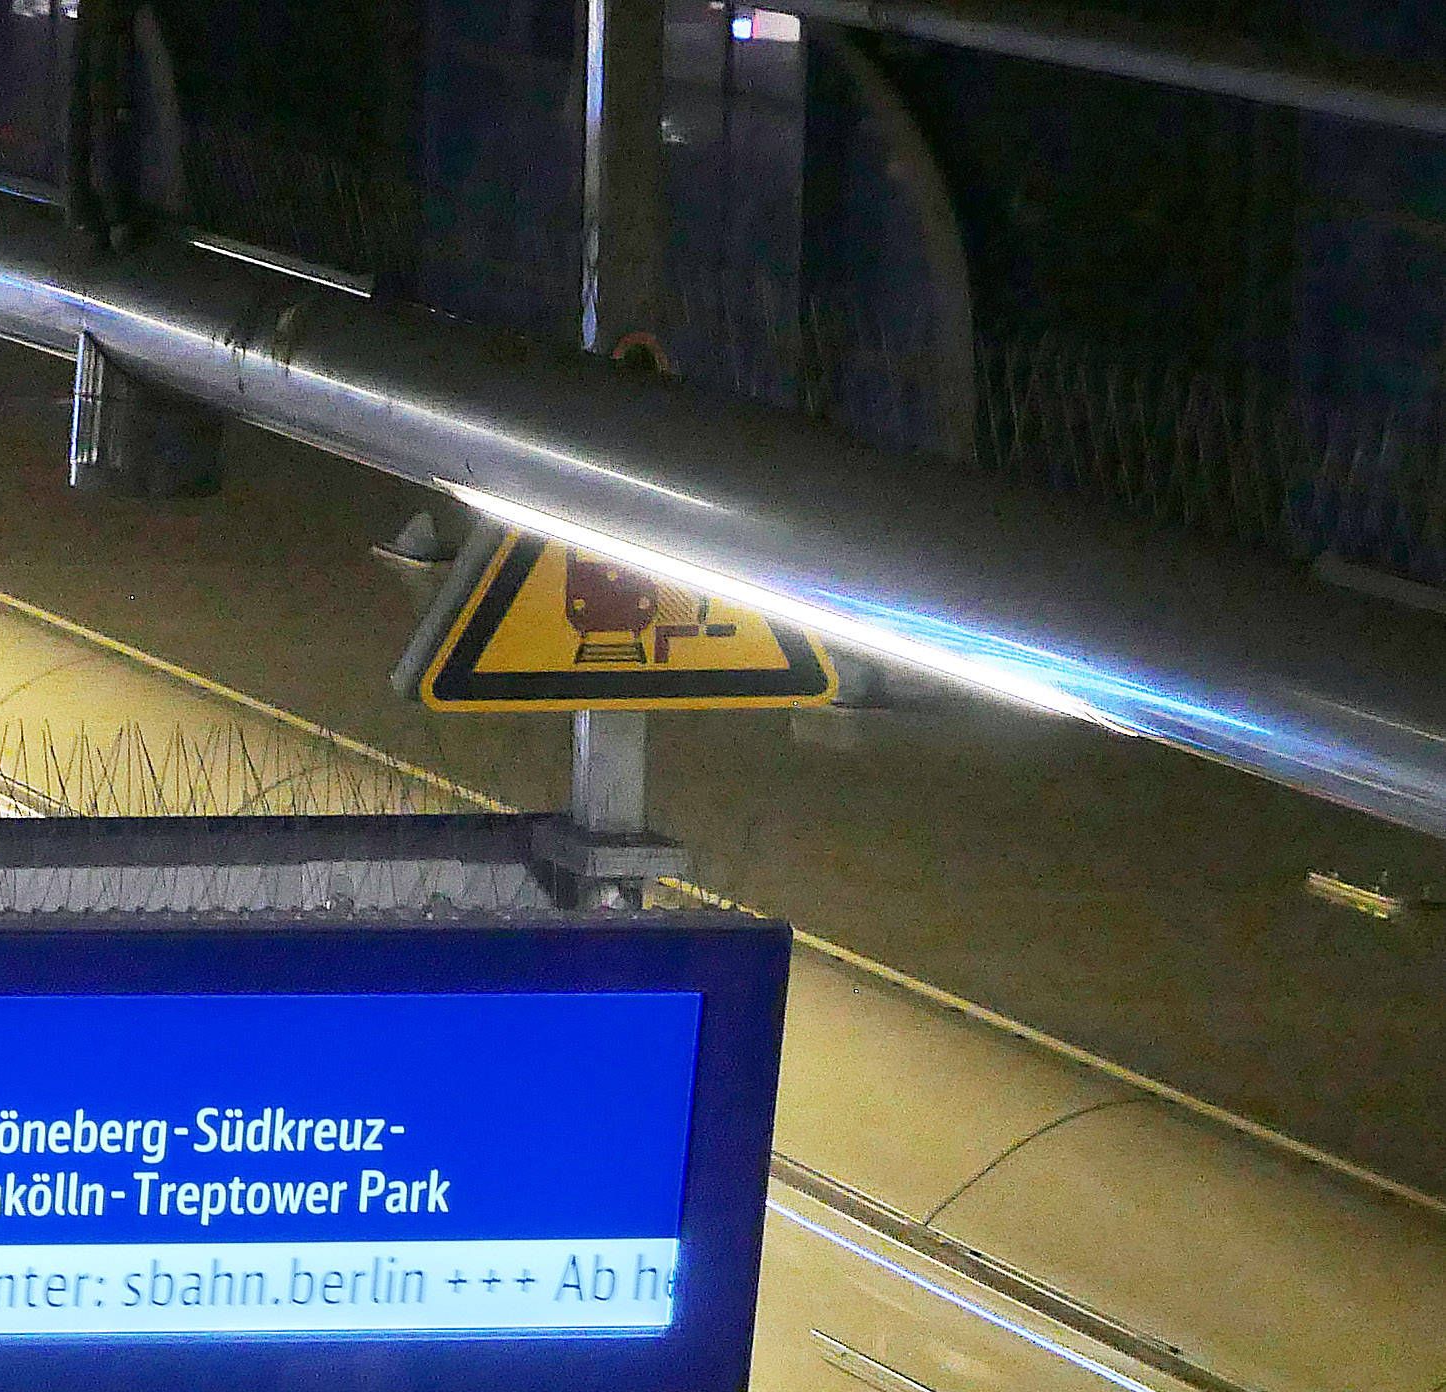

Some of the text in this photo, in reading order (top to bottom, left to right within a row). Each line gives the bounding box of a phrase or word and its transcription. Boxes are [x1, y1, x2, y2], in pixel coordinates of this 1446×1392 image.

[357, 1168, 451, 1213] Park
[121, 1255, 426, 1307] sbahn.berlin
[552, 1252, 616, 1302] Ab
